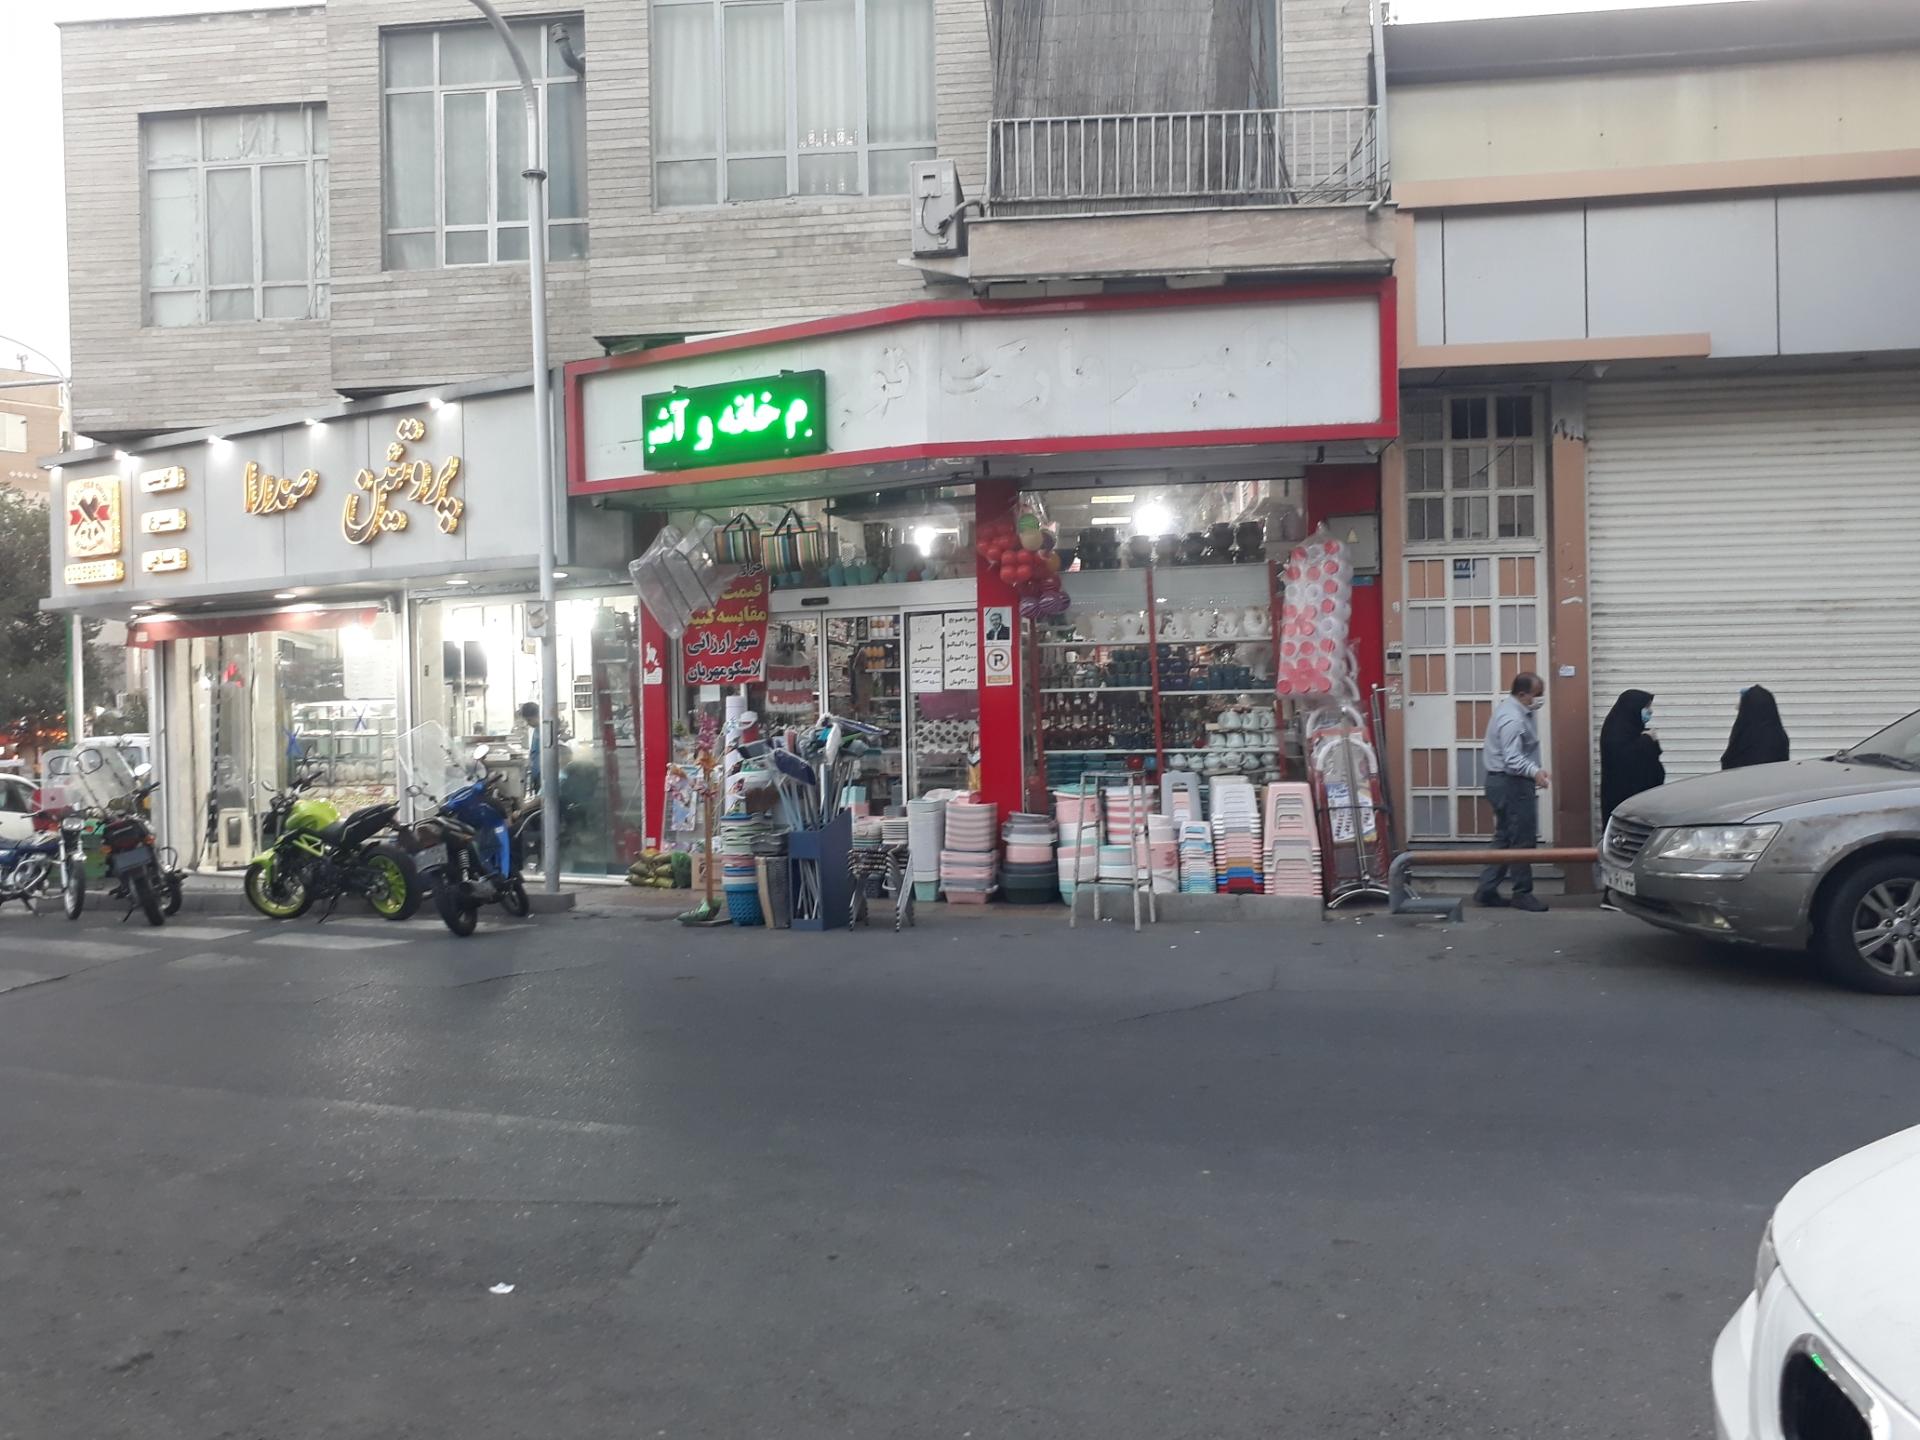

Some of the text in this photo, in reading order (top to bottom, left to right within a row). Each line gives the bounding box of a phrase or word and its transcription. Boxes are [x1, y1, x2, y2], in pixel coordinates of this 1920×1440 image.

[718, 391, 781, 435] خانه
[693, 415, 713, 451] و
[243, 418, 464, 545] پروتئین صدرا
[720, 579, 763, 602] قیمت
[716, 604, 767, 627] مقایسه
[687, 629, 760, 656] شهر ارزانی
[994, 653, 1004, 667] P
